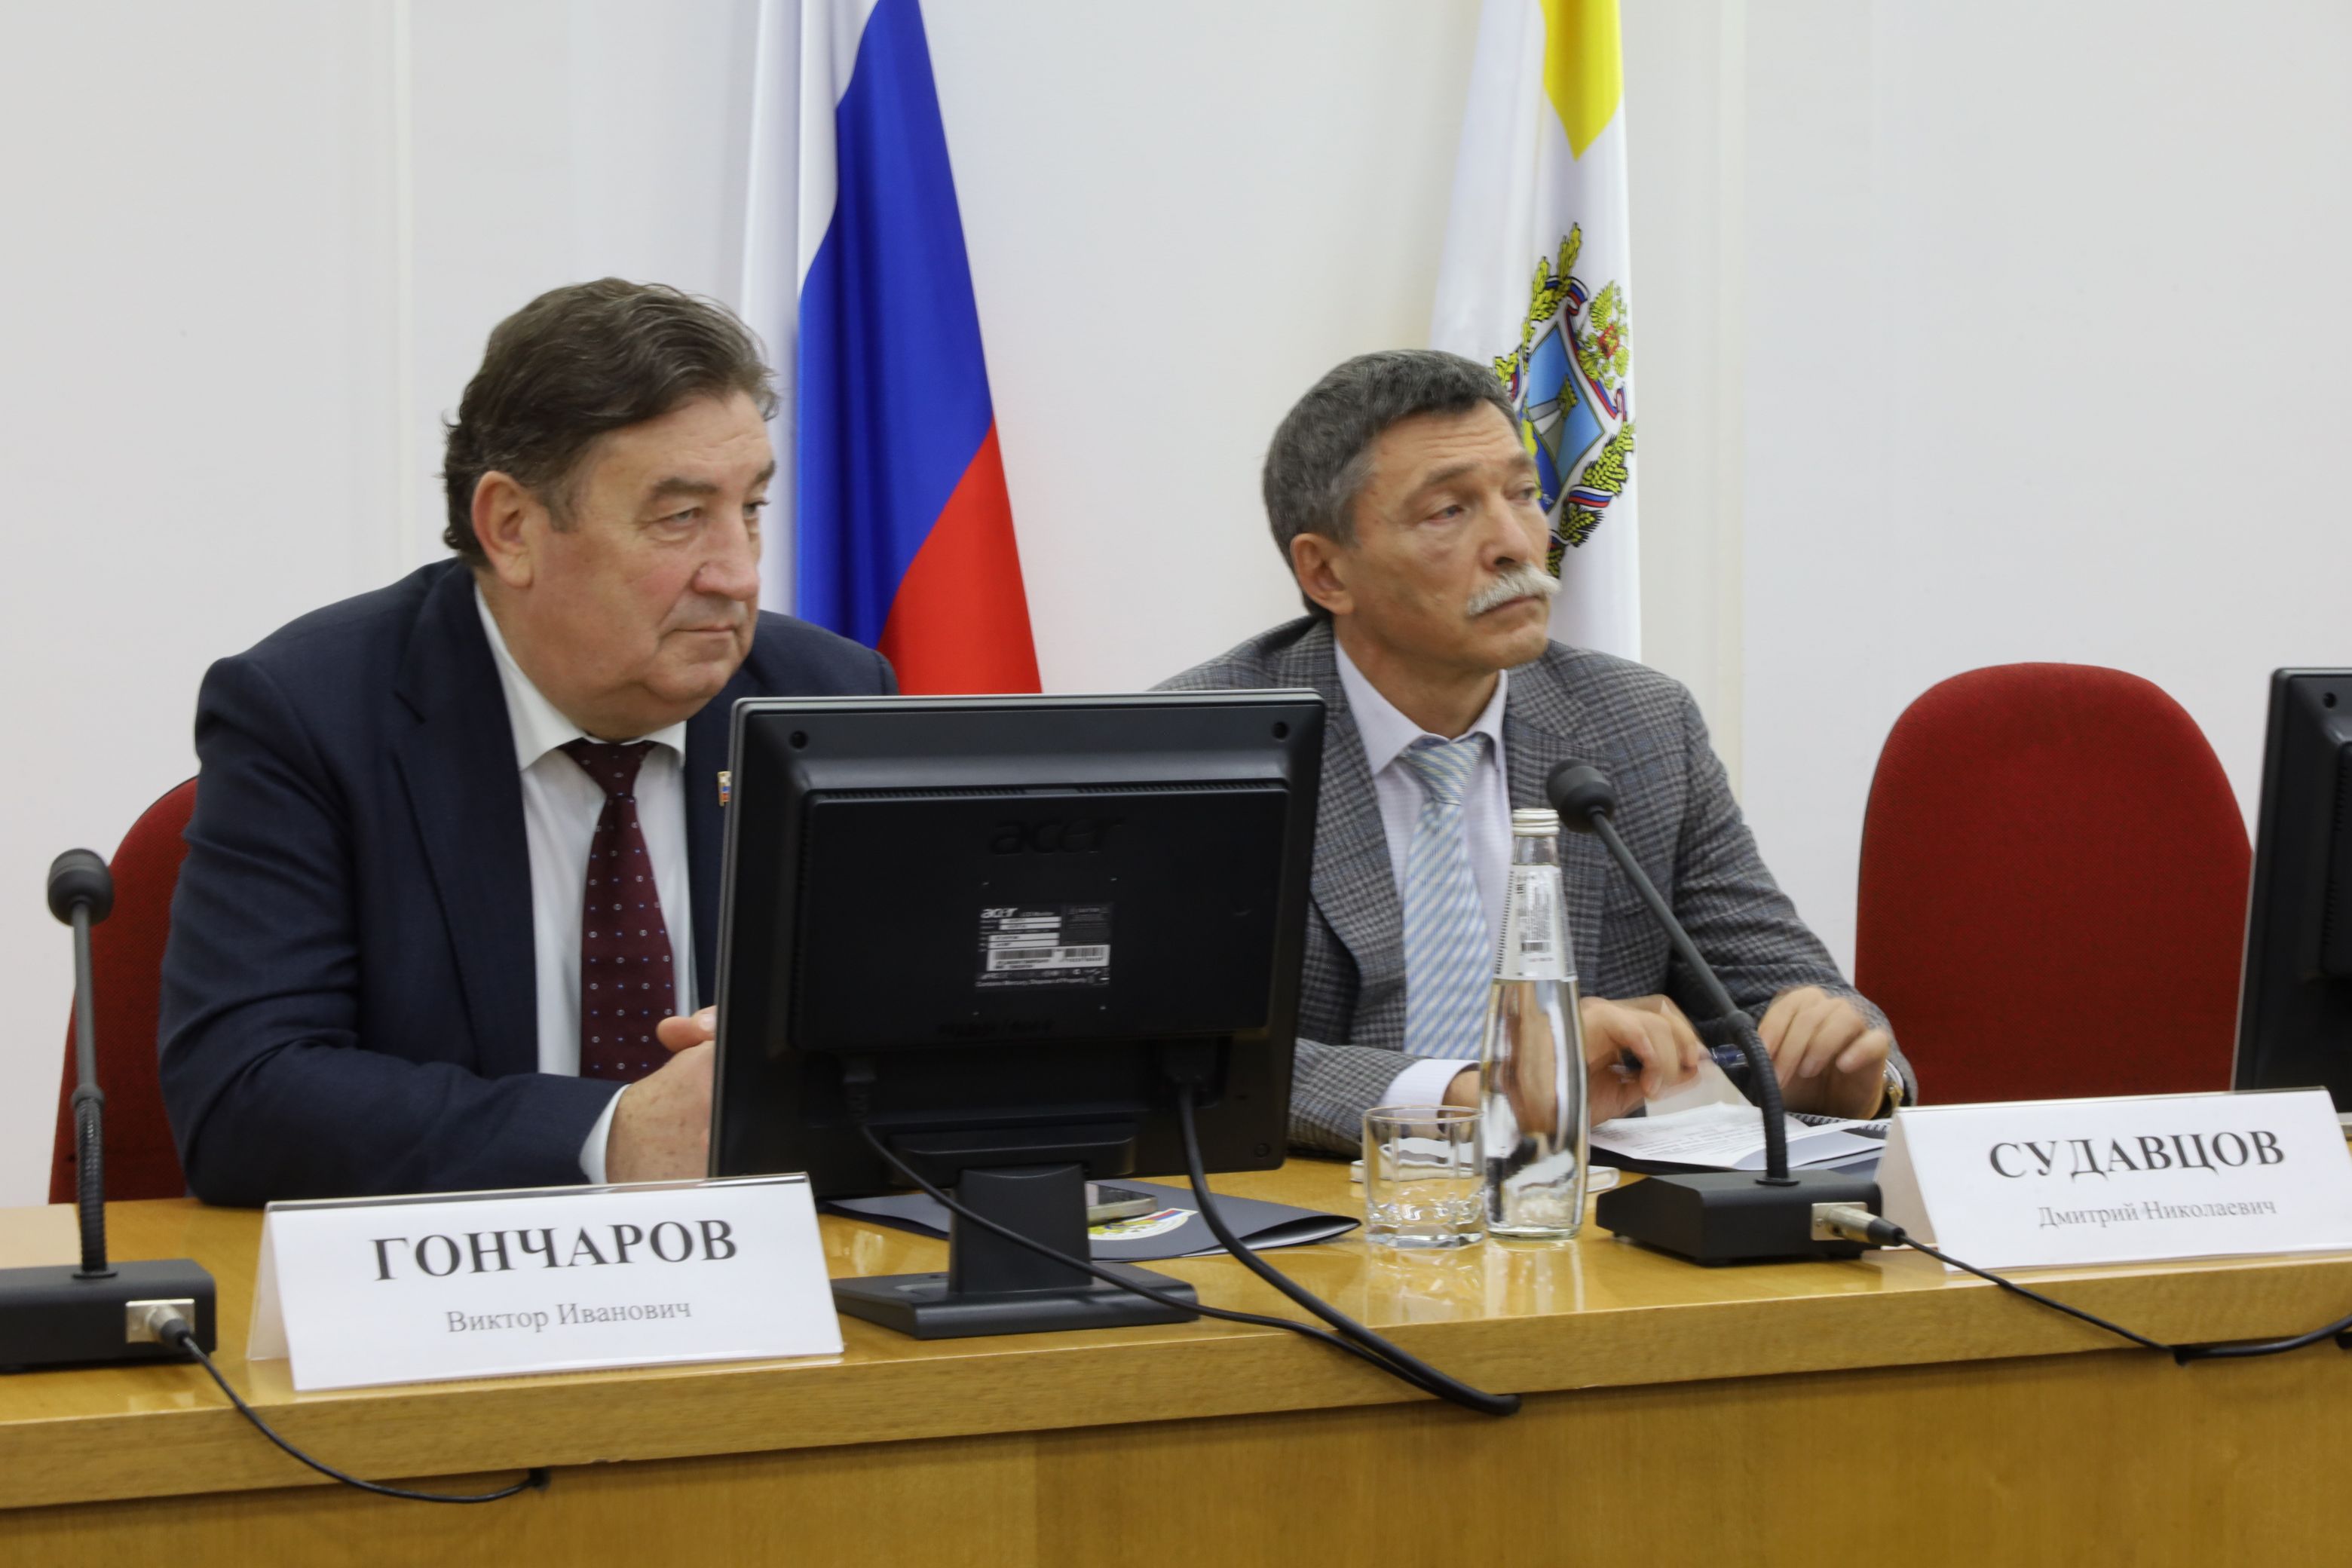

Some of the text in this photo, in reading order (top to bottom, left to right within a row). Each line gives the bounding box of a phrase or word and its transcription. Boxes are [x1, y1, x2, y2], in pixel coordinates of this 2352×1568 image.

[989, 816, 1126, 856] acer
[980, 908, 1018, 919] acer
[1989, 1131, 2285, 1181] СУДАВЦОВ
[2038, 1200, 2277, 1228] Дмитрий Николаевич
[370, 1219, 738, 1281] ГОНЧАРОВ
[446, 1302, 692, 1334] Виктор Иванович
